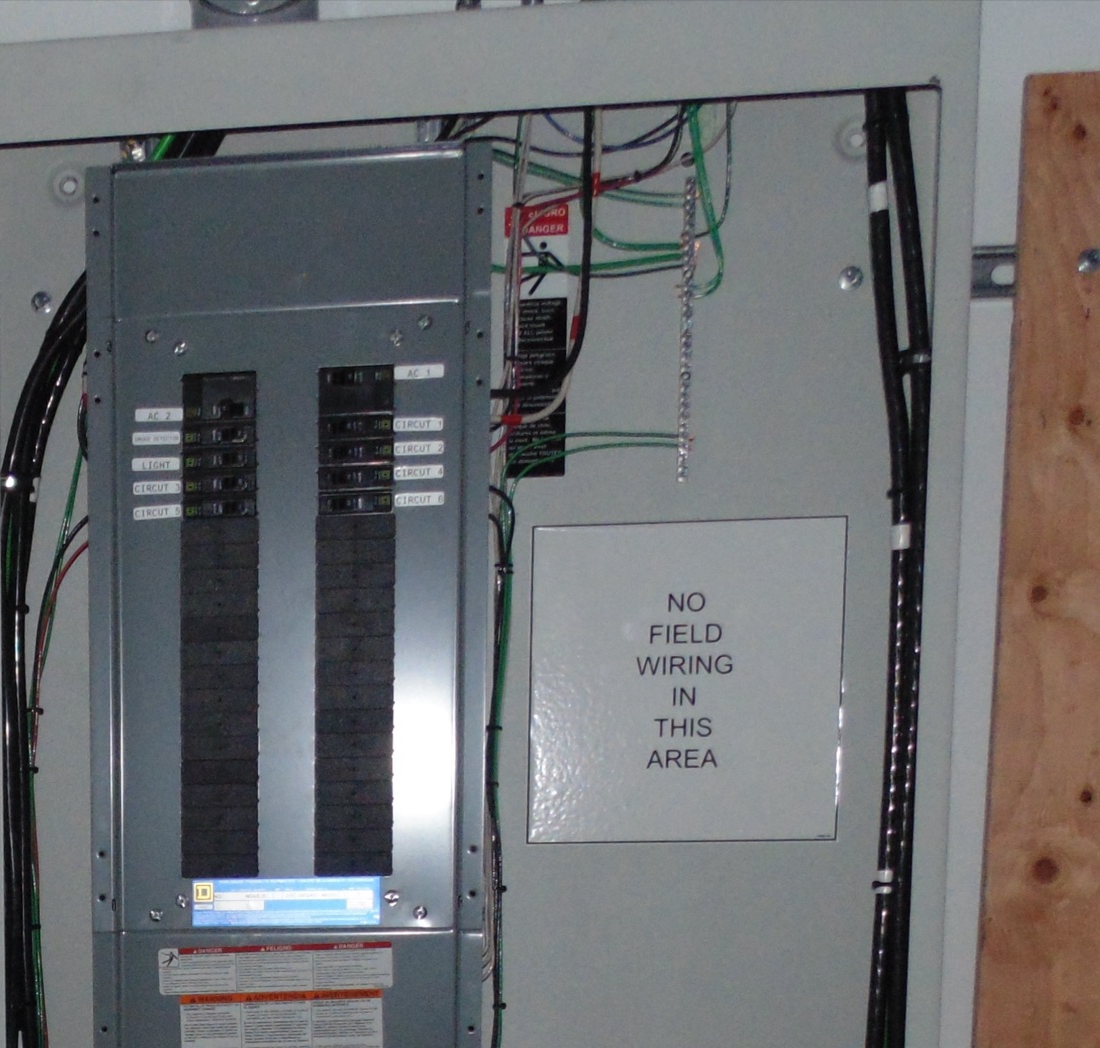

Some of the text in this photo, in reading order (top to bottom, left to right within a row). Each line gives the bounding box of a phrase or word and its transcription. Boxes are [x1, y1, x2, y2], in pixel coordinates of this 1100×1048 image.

[407, 369, 431, 378] AC 1
[147, 412, 171, 420] AC 2
[437, 443, 444, 453] 2
[142, 461, 171, 470] LIGHT
[437, 467, 443, 477] 4
[438, 494, 444, 503] 6
[175, 506, 181, 516] 5
[668, 592, 706, 612] NO
[650, 624, 723, 644] FIELD
[636, 654, 733, 675] WIRING
[672, 687, 696, 706] IN
[654, 717, 712, 737] THIS
[646, 749, 718, 769] AREA
